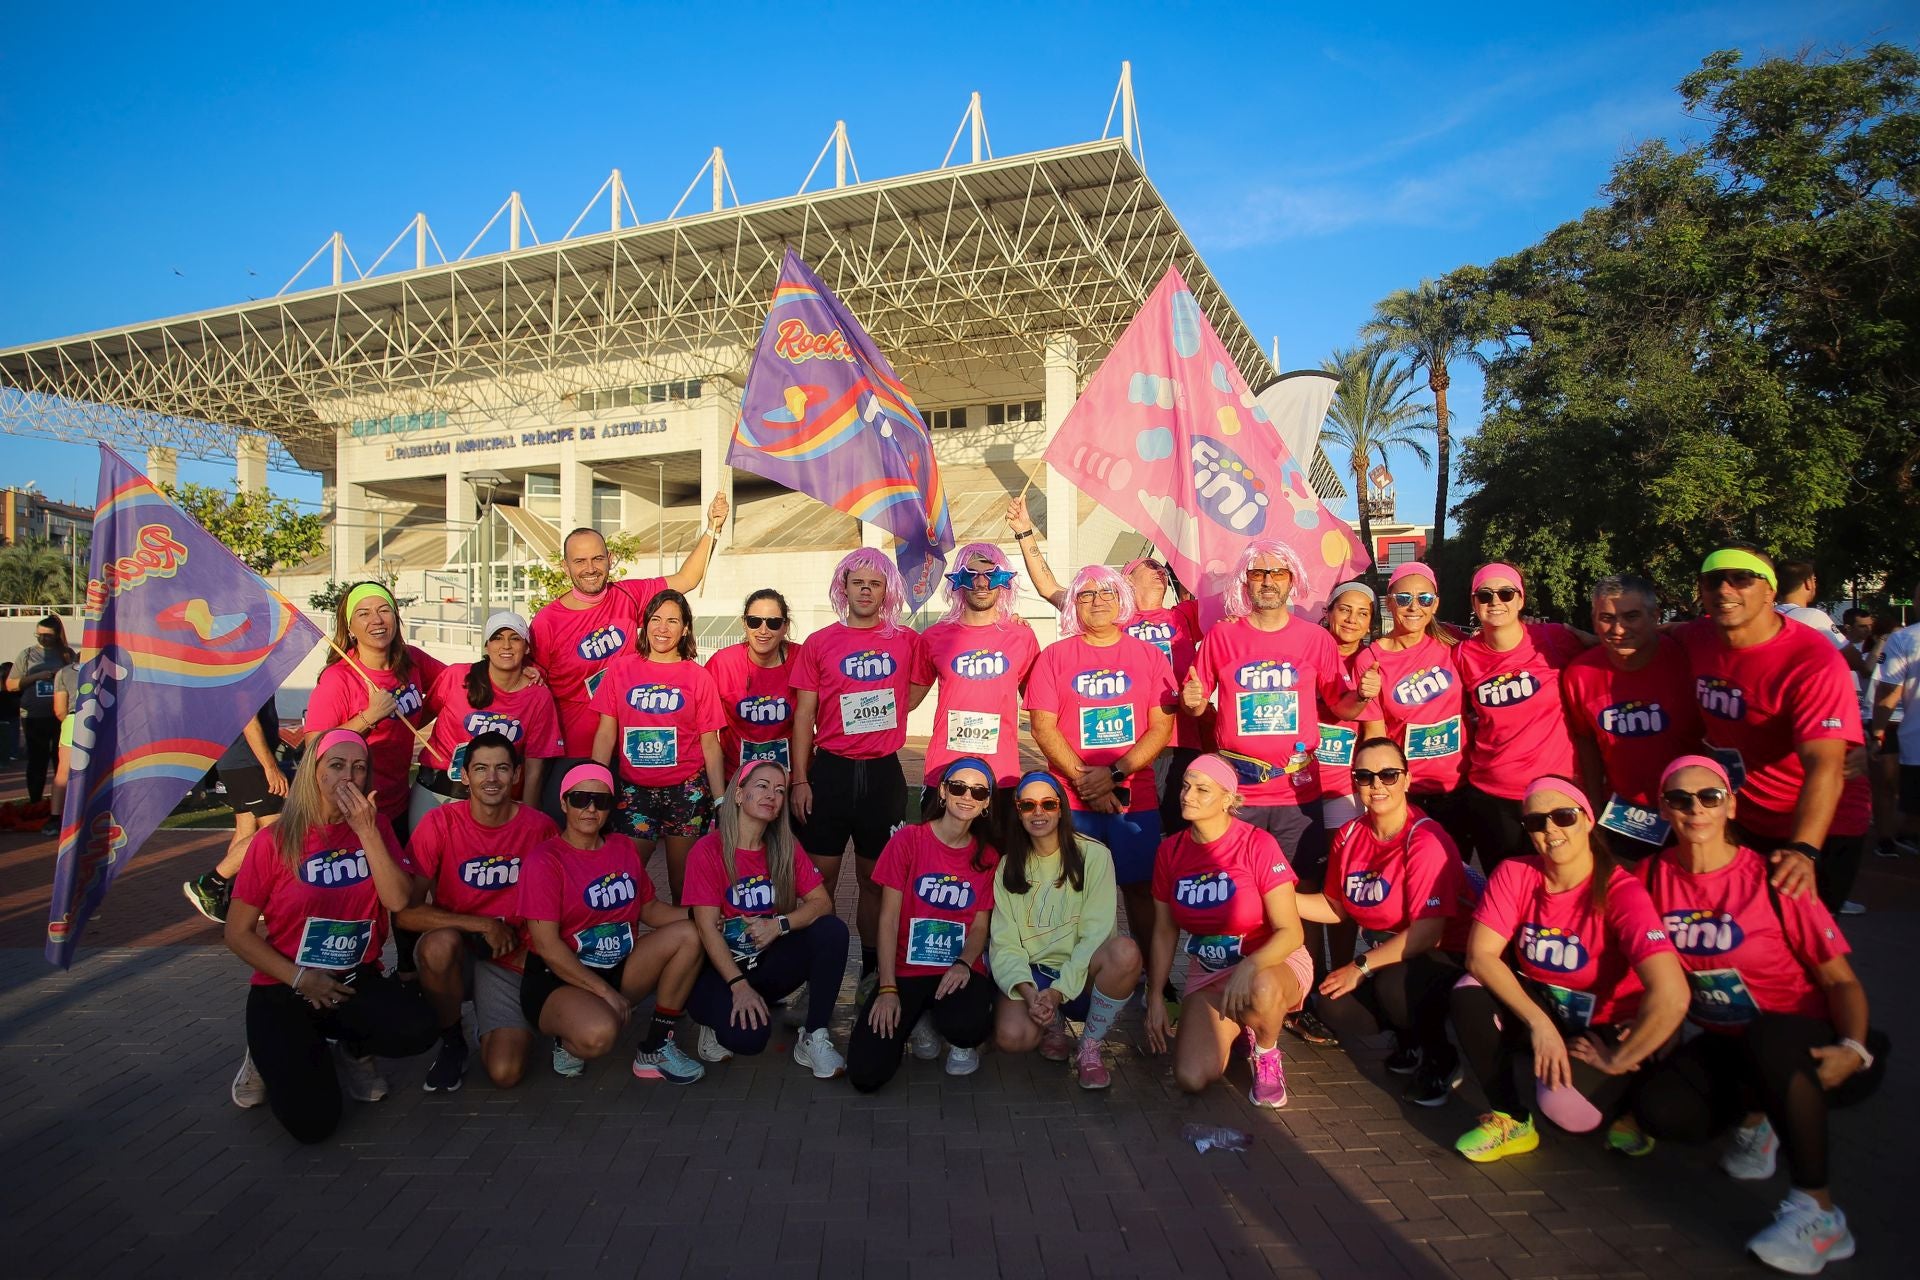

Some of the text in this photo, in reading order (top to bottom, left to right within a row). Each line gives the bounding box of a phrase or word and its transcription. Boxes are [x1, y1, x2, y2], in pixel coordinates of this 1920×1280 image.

[396, 418, 667, 460] PABELLÓN MUNICIPAL PRÍNCIPE DE ASTURIAS
[1192, 440, 1269, 530] Fini
[581, 625, 623, 658] Fini
[1128, 622, 1171, 640] Fini
[845, 652, 891, 678] Fini
[956, 651, 1004, 677] Fini
[1240, 662, 1291, 690] Fini
[1077, 670, 1126, 697] Fini
[1396, 665, 1449, 704] Fini
[1478, 671, 1533, 705] Fini
[630, 688, 681, 711] Fini
[741, 698, 786, 722] Fini
[853, 705, 888, 720] 2094
[1253, 704, 1284, 718] 422
[468, 714, 520, 742] Fini
[1095, 718, 1124, 732] 410
[1603, 703, 1661, 734] Fini
[956, 726, 990, 740] 2092
[1421, 732, 1449, 747] 431
[637, 741, 664, 754] 439
[1623, 806, 1658, 826] 405
[306, 849, 369, 885] Fini
[464, 857, 521, 887] Fini
[588, 872, 635, 908] Fini
[919, 877, 971, 908] Fini
[1176, 872, 1228, 905] Fini
[322, 934, 358, 950] 406
[595, 936, 621, 950] 408
[924, 934, 952, 949] 444
[1663, 913, 1733, 951] Fini
[1198, 945, 1227, 960] 430
[1518, 926, 1579, 970] Fini
